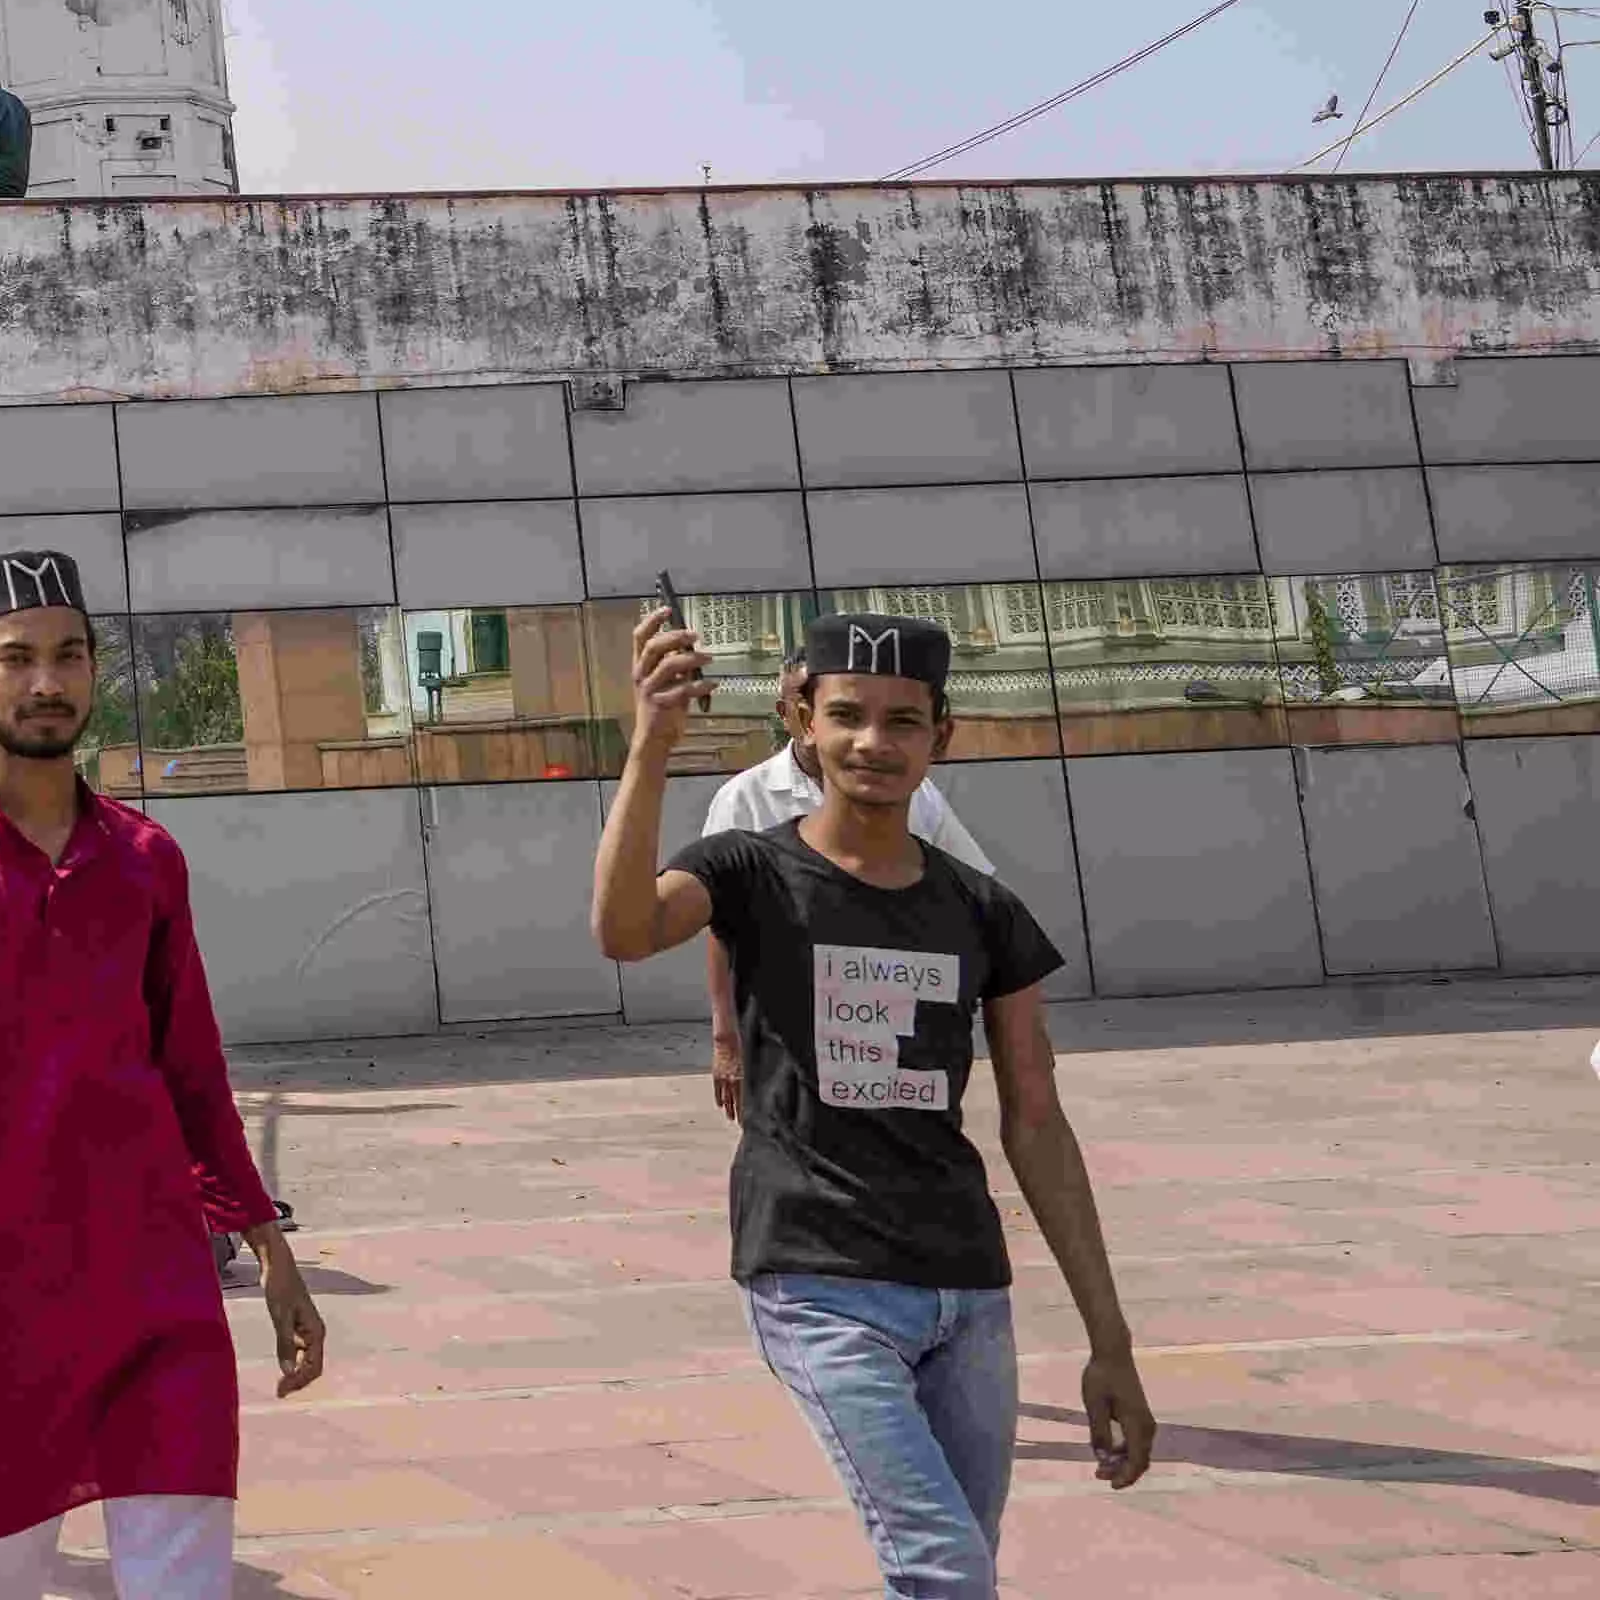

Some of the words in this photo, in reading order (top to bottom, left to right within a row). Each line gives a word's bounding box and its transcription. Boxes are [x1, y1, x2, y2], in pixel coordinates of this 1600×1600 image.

[826, 953, 833, 977] i
[843, 955, 942, 991] always
[826, 995, 889, 1025] look
[829, 1039, 883, 1064] this
[831, 1076, 937, 1104] excited
